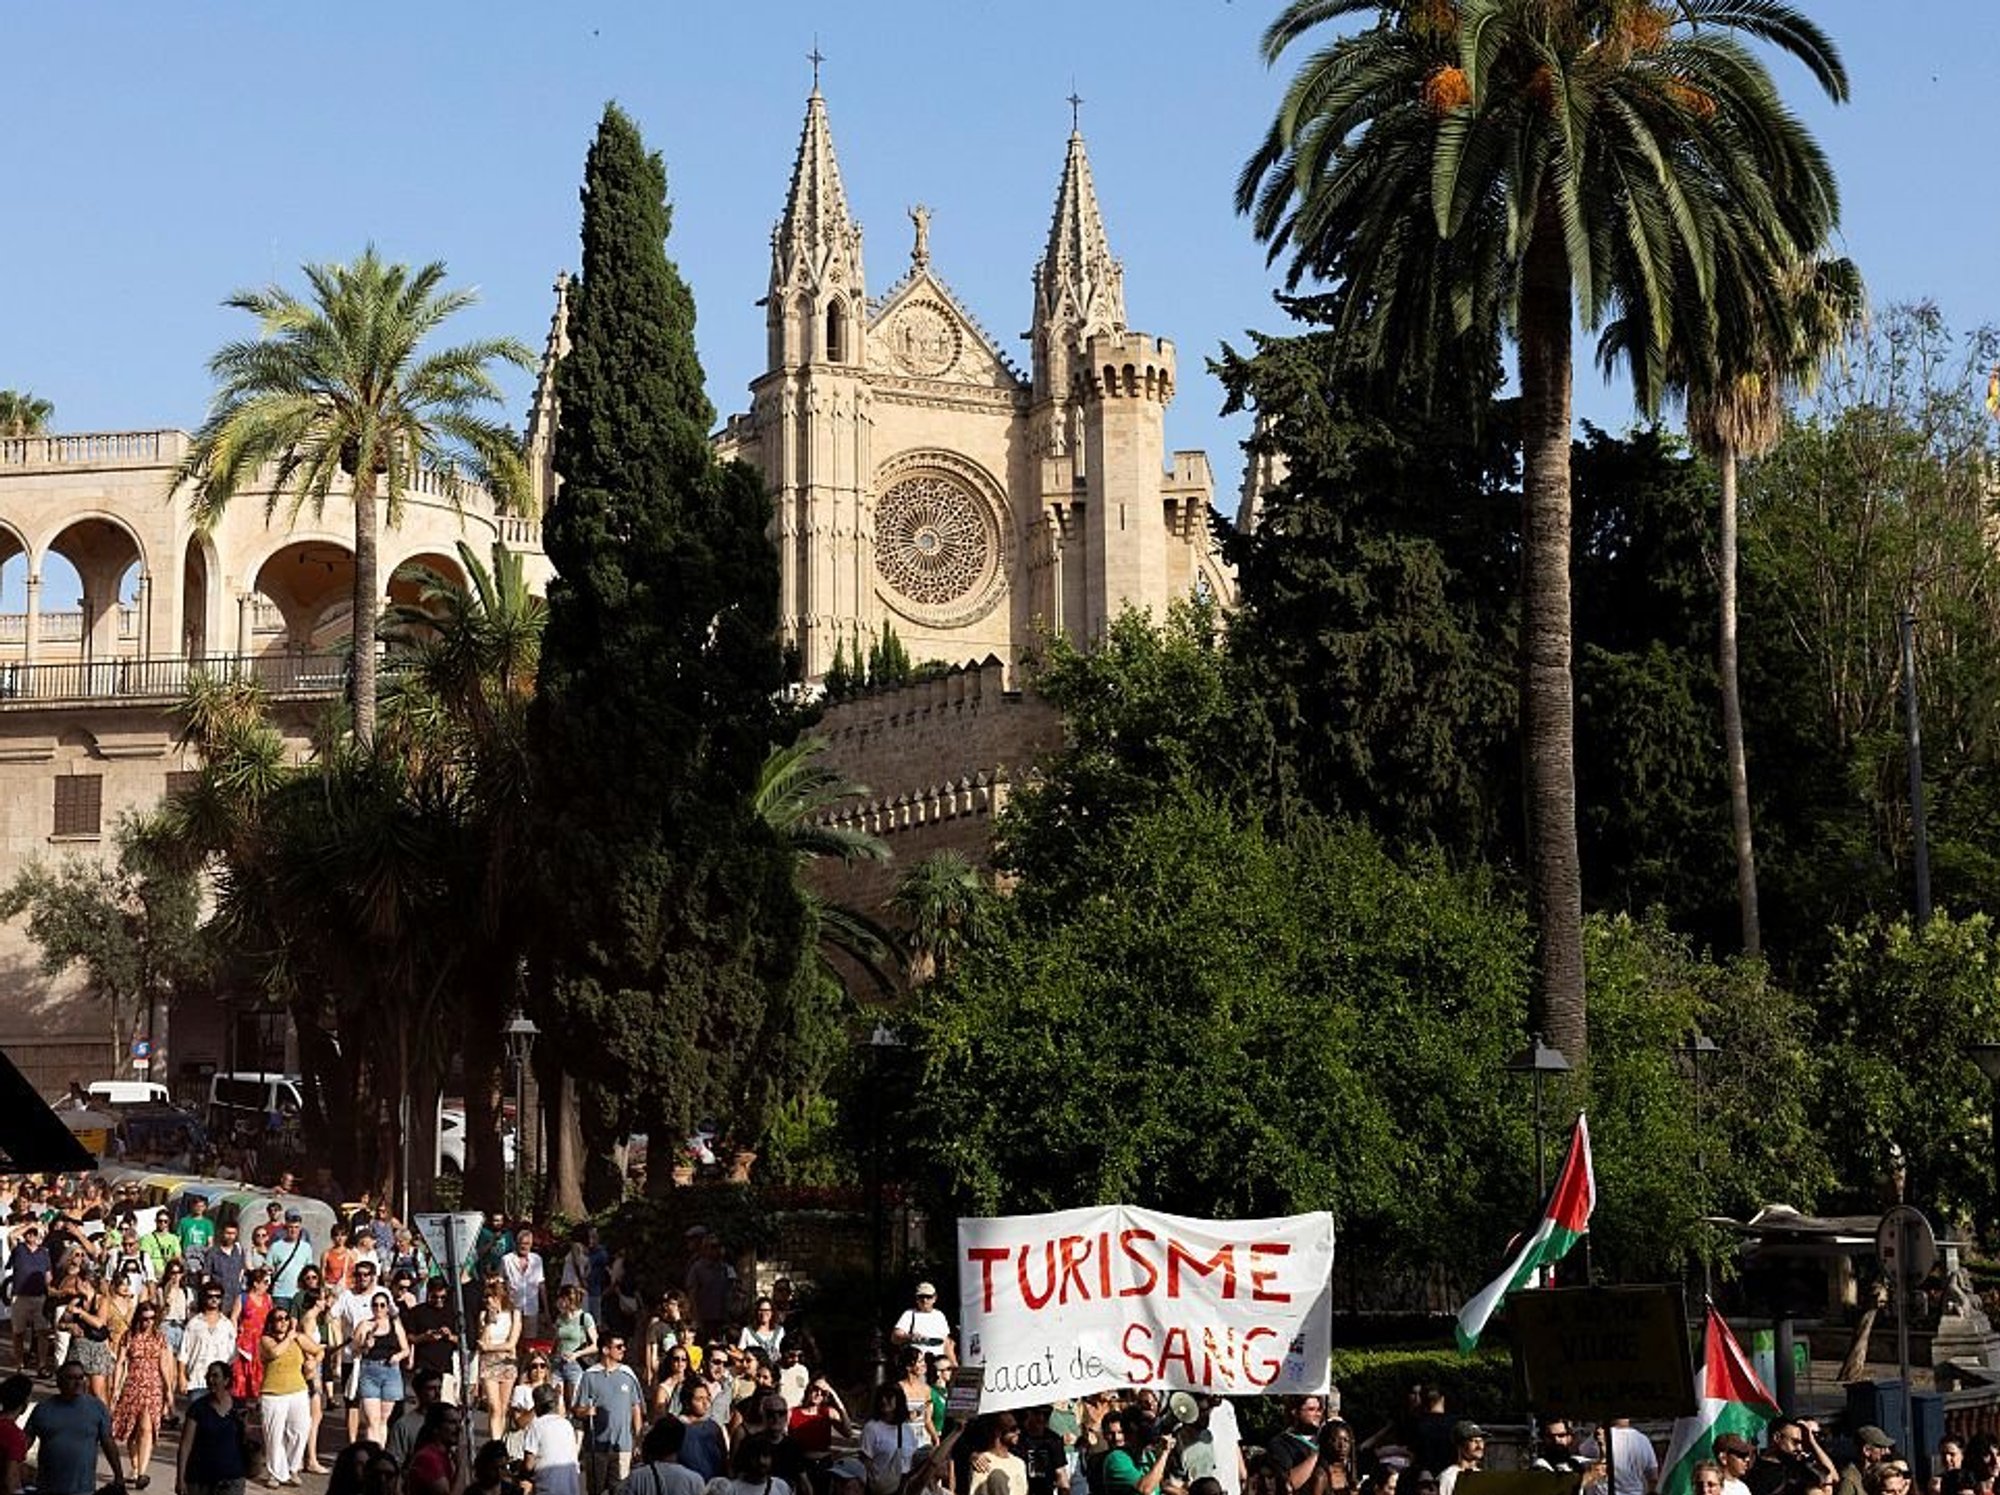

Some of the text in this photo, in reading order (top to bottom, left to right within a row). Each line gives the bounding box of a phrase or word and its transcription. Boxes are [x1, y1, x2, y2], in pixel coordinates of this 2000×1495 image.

[967, 1229, 1292, 1314] TURISME
[1069, 1346, 1104, 1380] de
[1122, 1322, 1281, 1388] SANG
